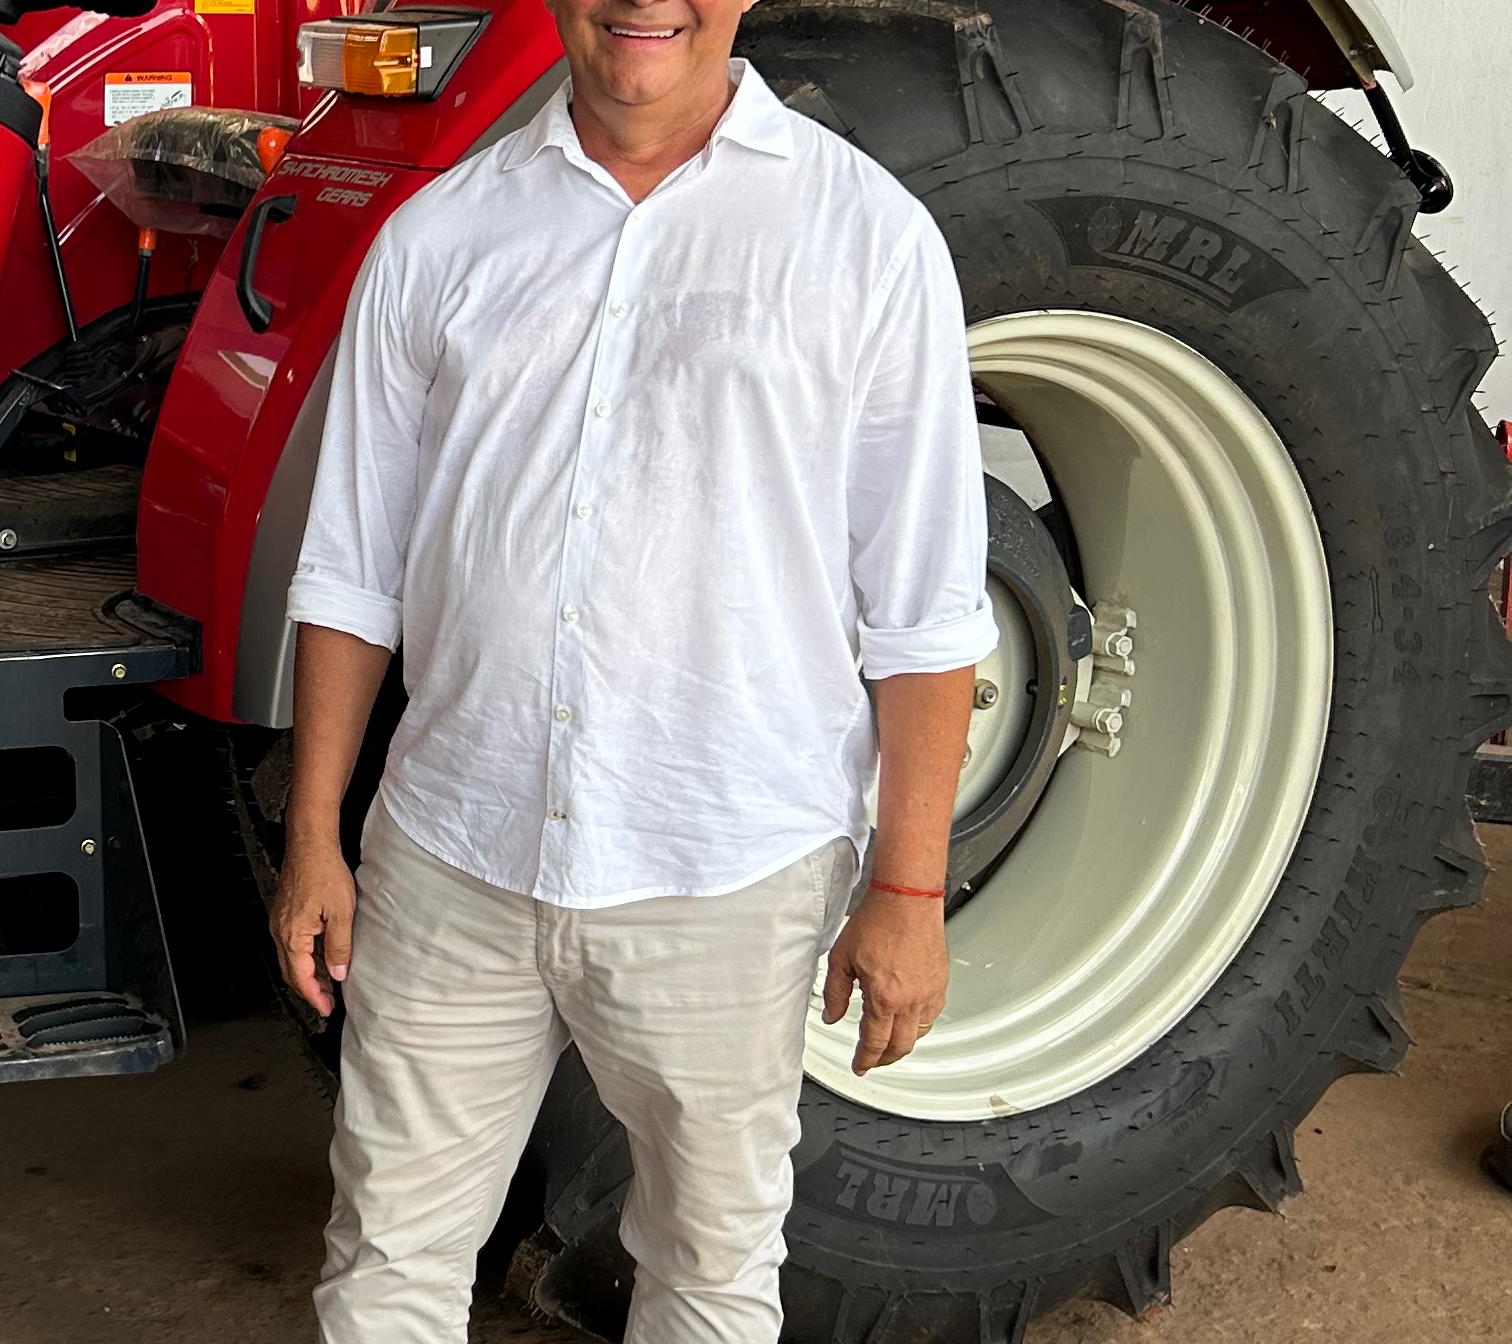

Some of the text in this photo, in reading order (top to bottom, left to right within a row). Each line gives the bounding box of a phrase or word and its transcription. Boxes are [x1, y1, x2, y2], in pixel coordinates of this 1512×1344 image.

[277, 160, 394, 188] SYNCHROMESH
[315, 186, 374, 208] GEARS
[1117, 208, 1253, 295] MRL
[1273, 844, 1382, 1036] KIRTI
[835, 1160, 963, 1227] MRL
